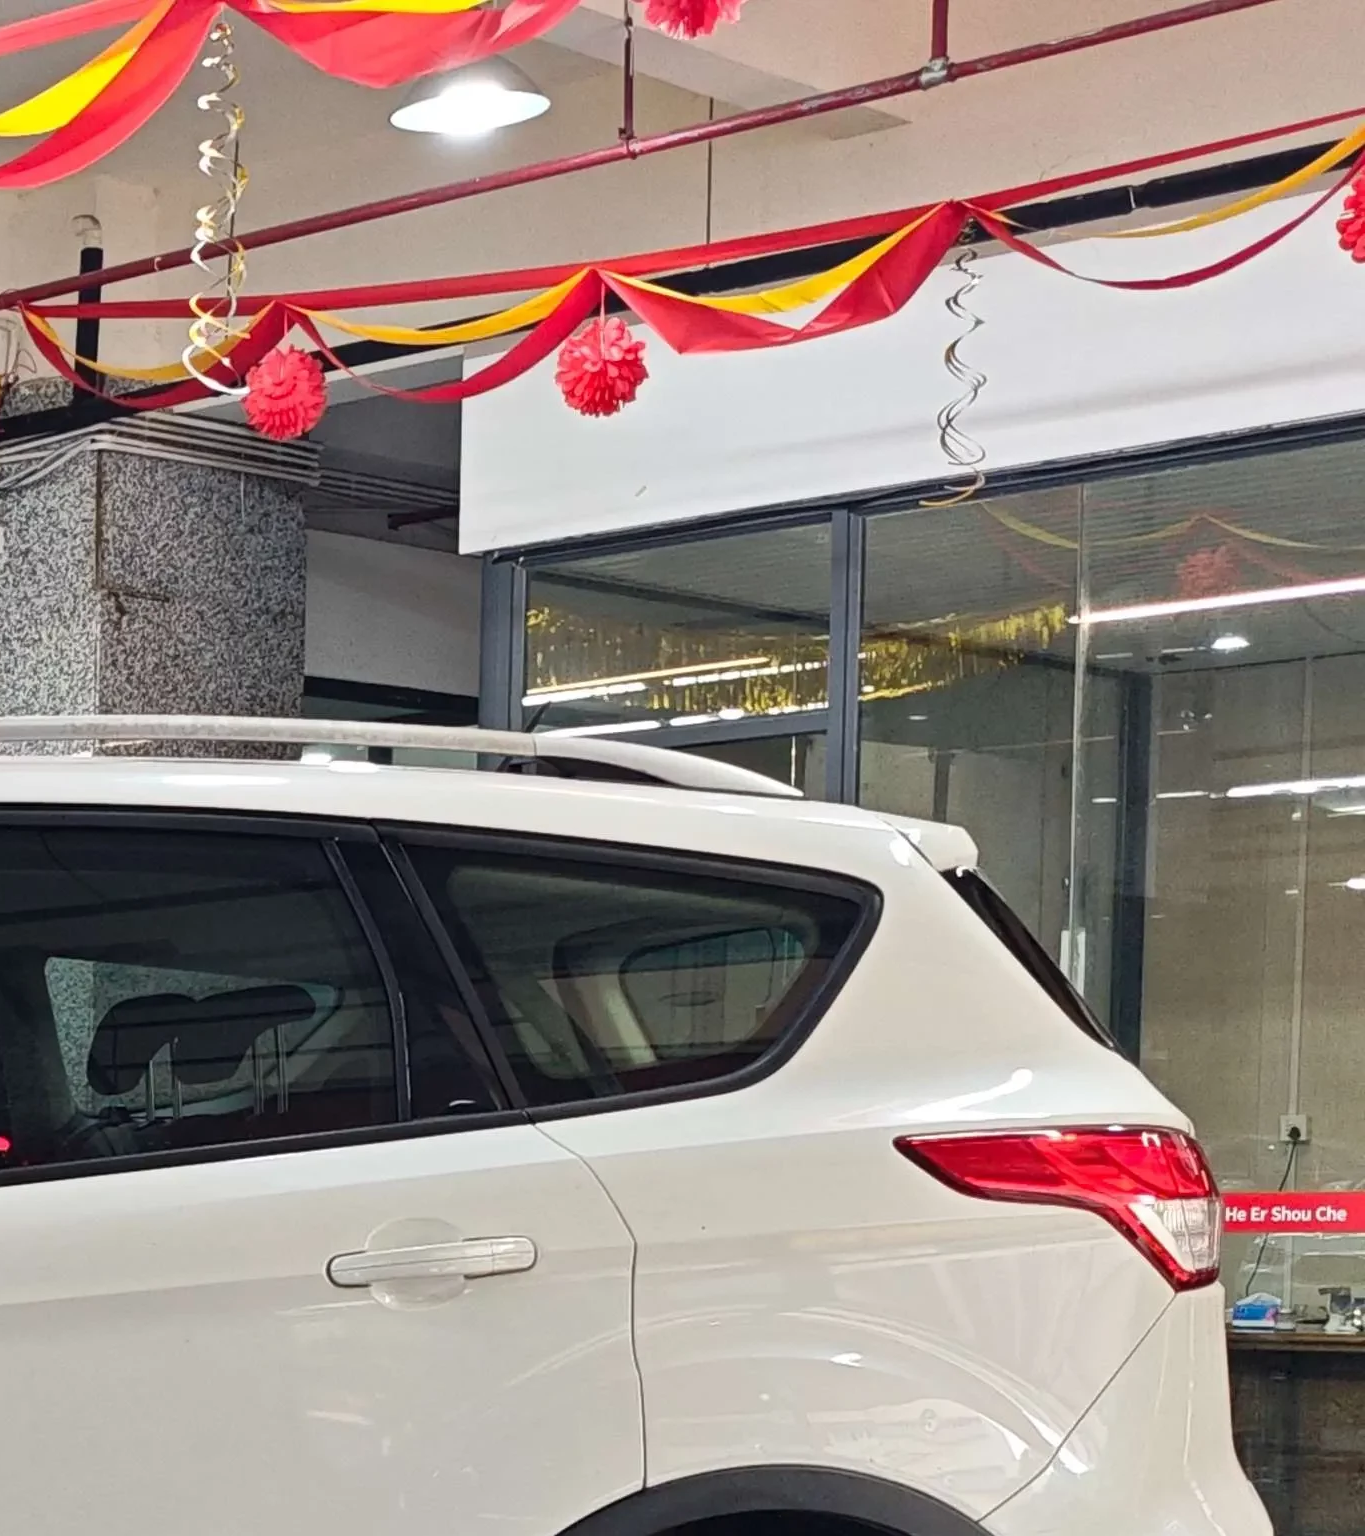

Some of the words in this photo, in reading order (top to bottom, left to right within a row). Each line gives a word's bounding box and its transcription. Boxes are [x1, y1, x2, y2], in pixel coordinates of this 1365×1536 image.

[1225, 1207, 1246, 1222] He
[1250, 1207, 1268, 1222] Er
[1271, 1206, 1312, 1222] Shou
[1315, 1206, 1348, 1222] Che
